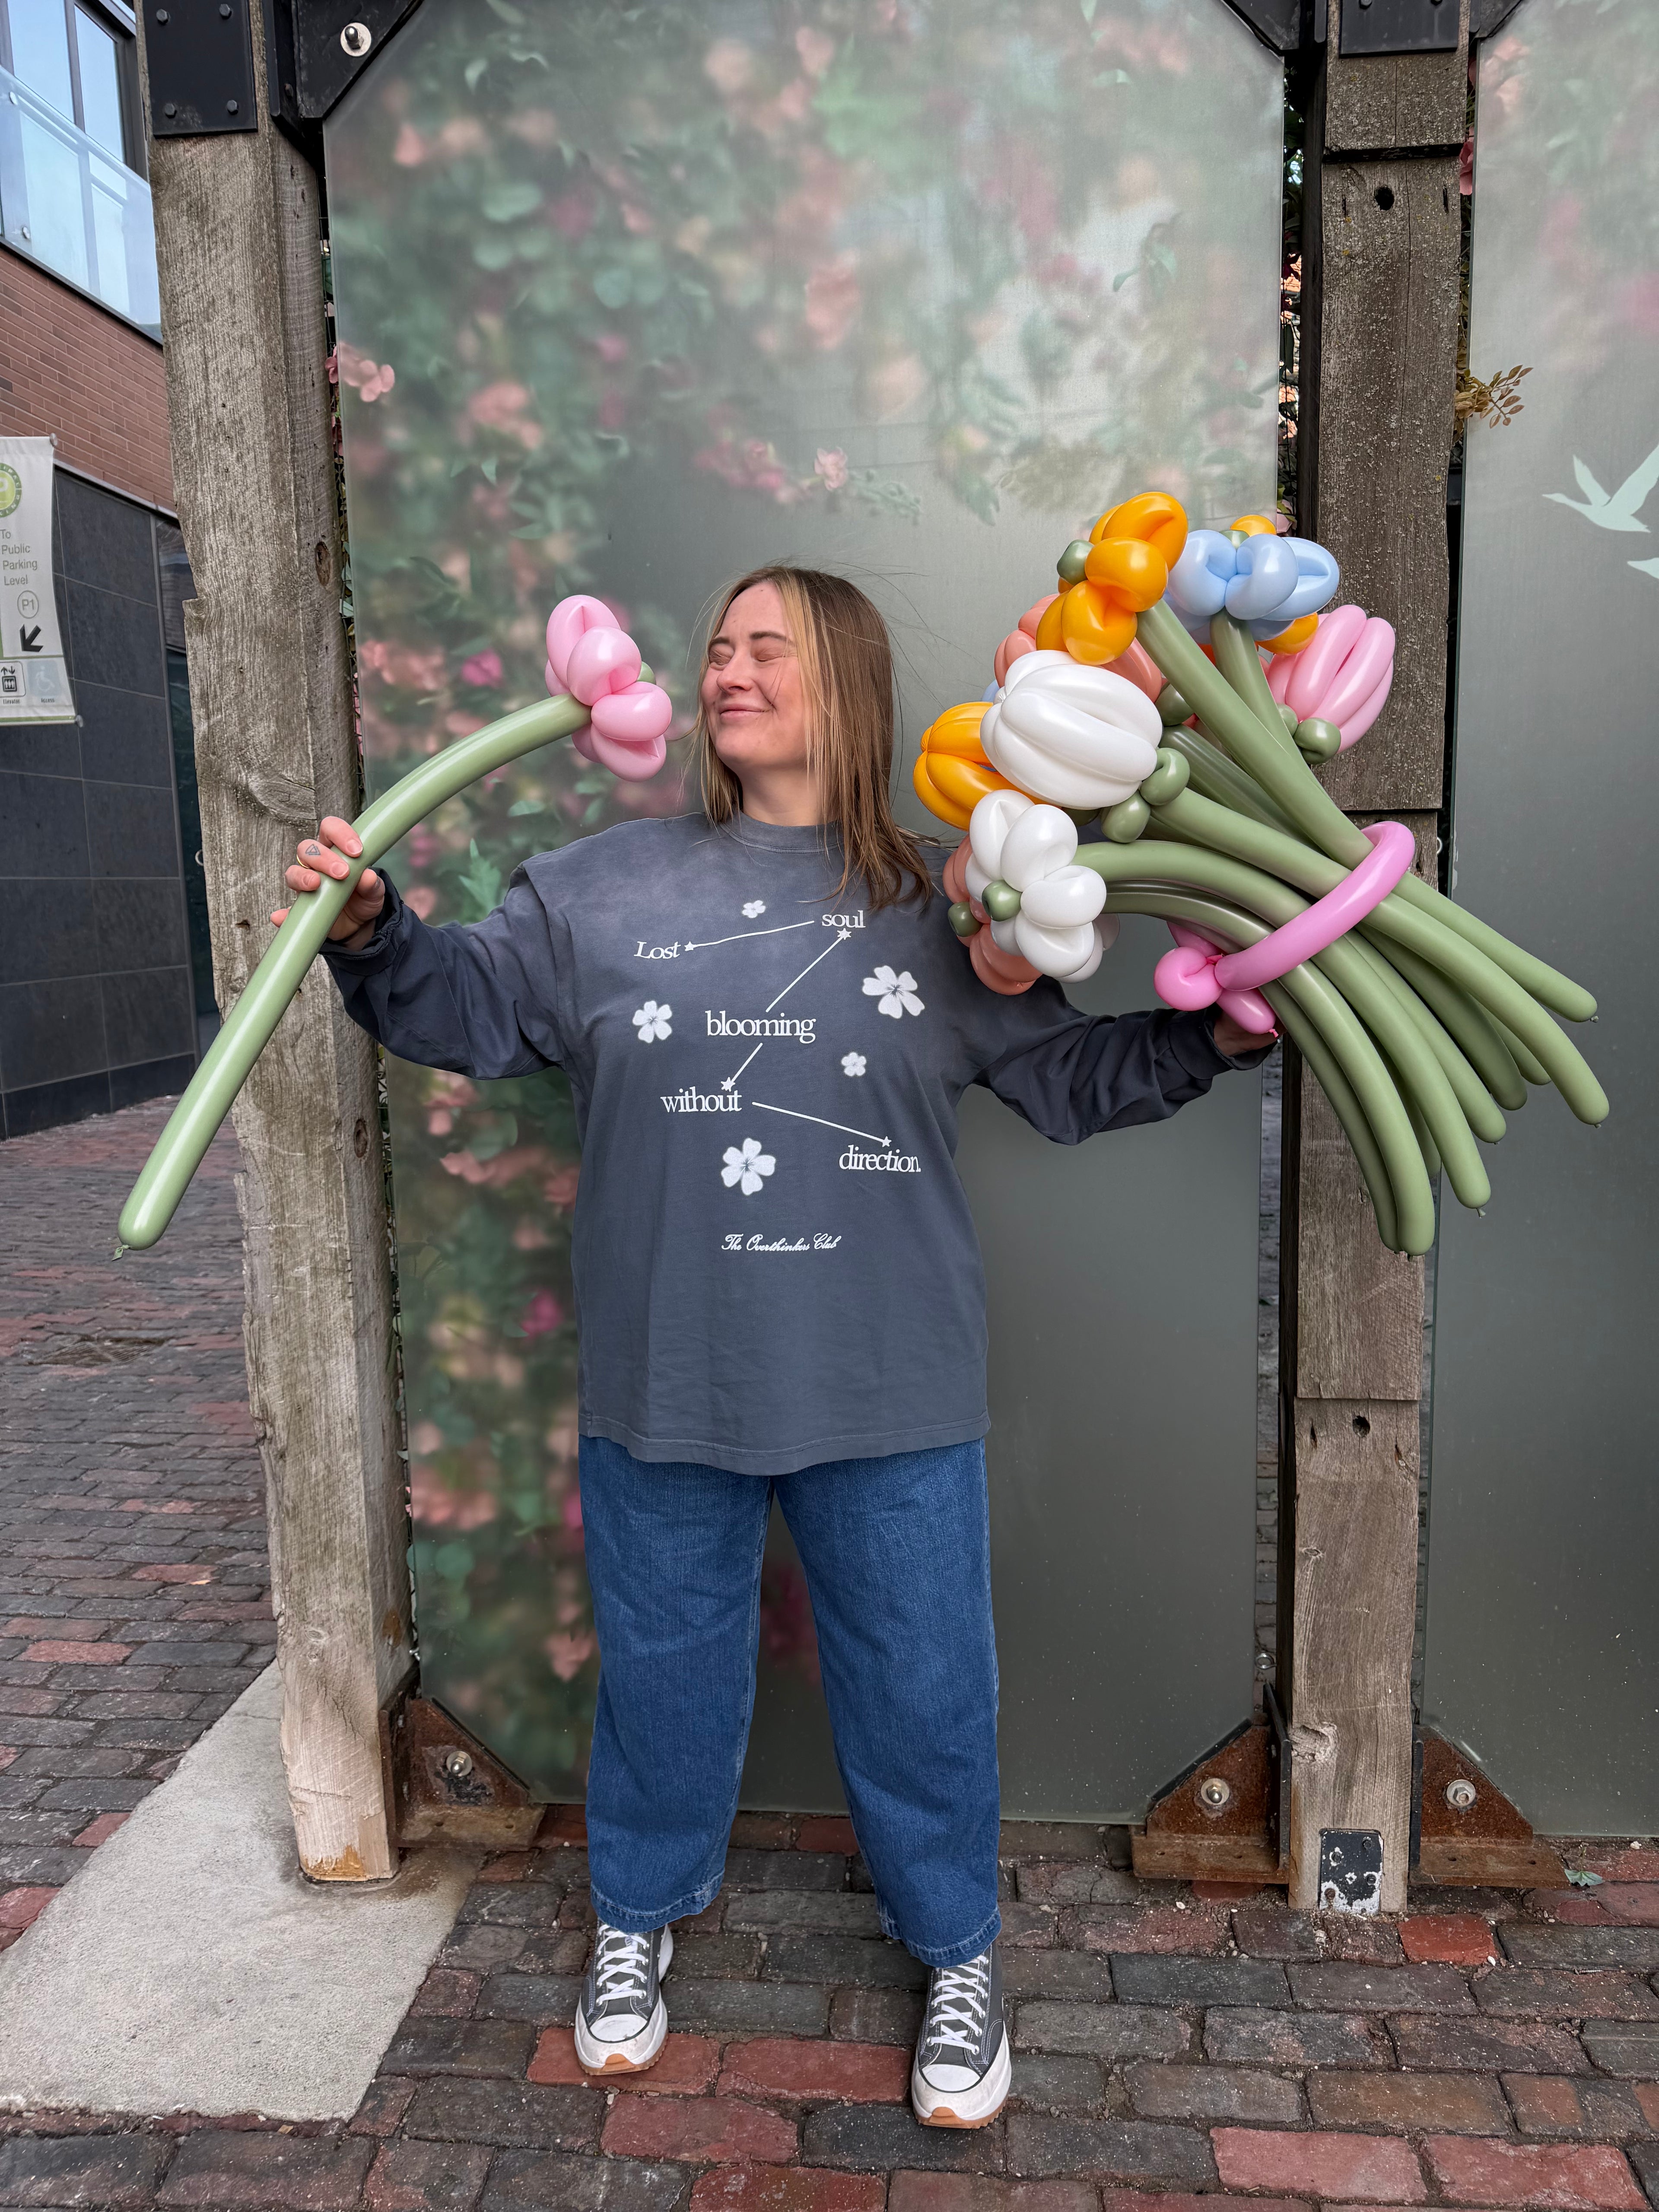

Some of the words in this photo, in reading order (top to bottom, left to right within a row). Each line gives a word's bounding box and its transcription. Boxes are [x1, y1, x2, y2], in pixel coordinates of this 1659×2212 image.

[0, 529, 11, 539] To
[2, 543, 30, 554] Public
[3, 559, 38, 571] Parking
[4, 574, 28, 586] Level
[22, 599, 35, 610] P1
[822, 910, 866, 929] soul
[634, 941, 681, 959] Lost
[705, 1010, 817, 1044] blooming
[661, 1087, 742, 1112] without
[721, 1233, 744, 1250] The
[746, 1234, 810, 1251] Overthinkers
[814, 1233, 842, 1249] Club
